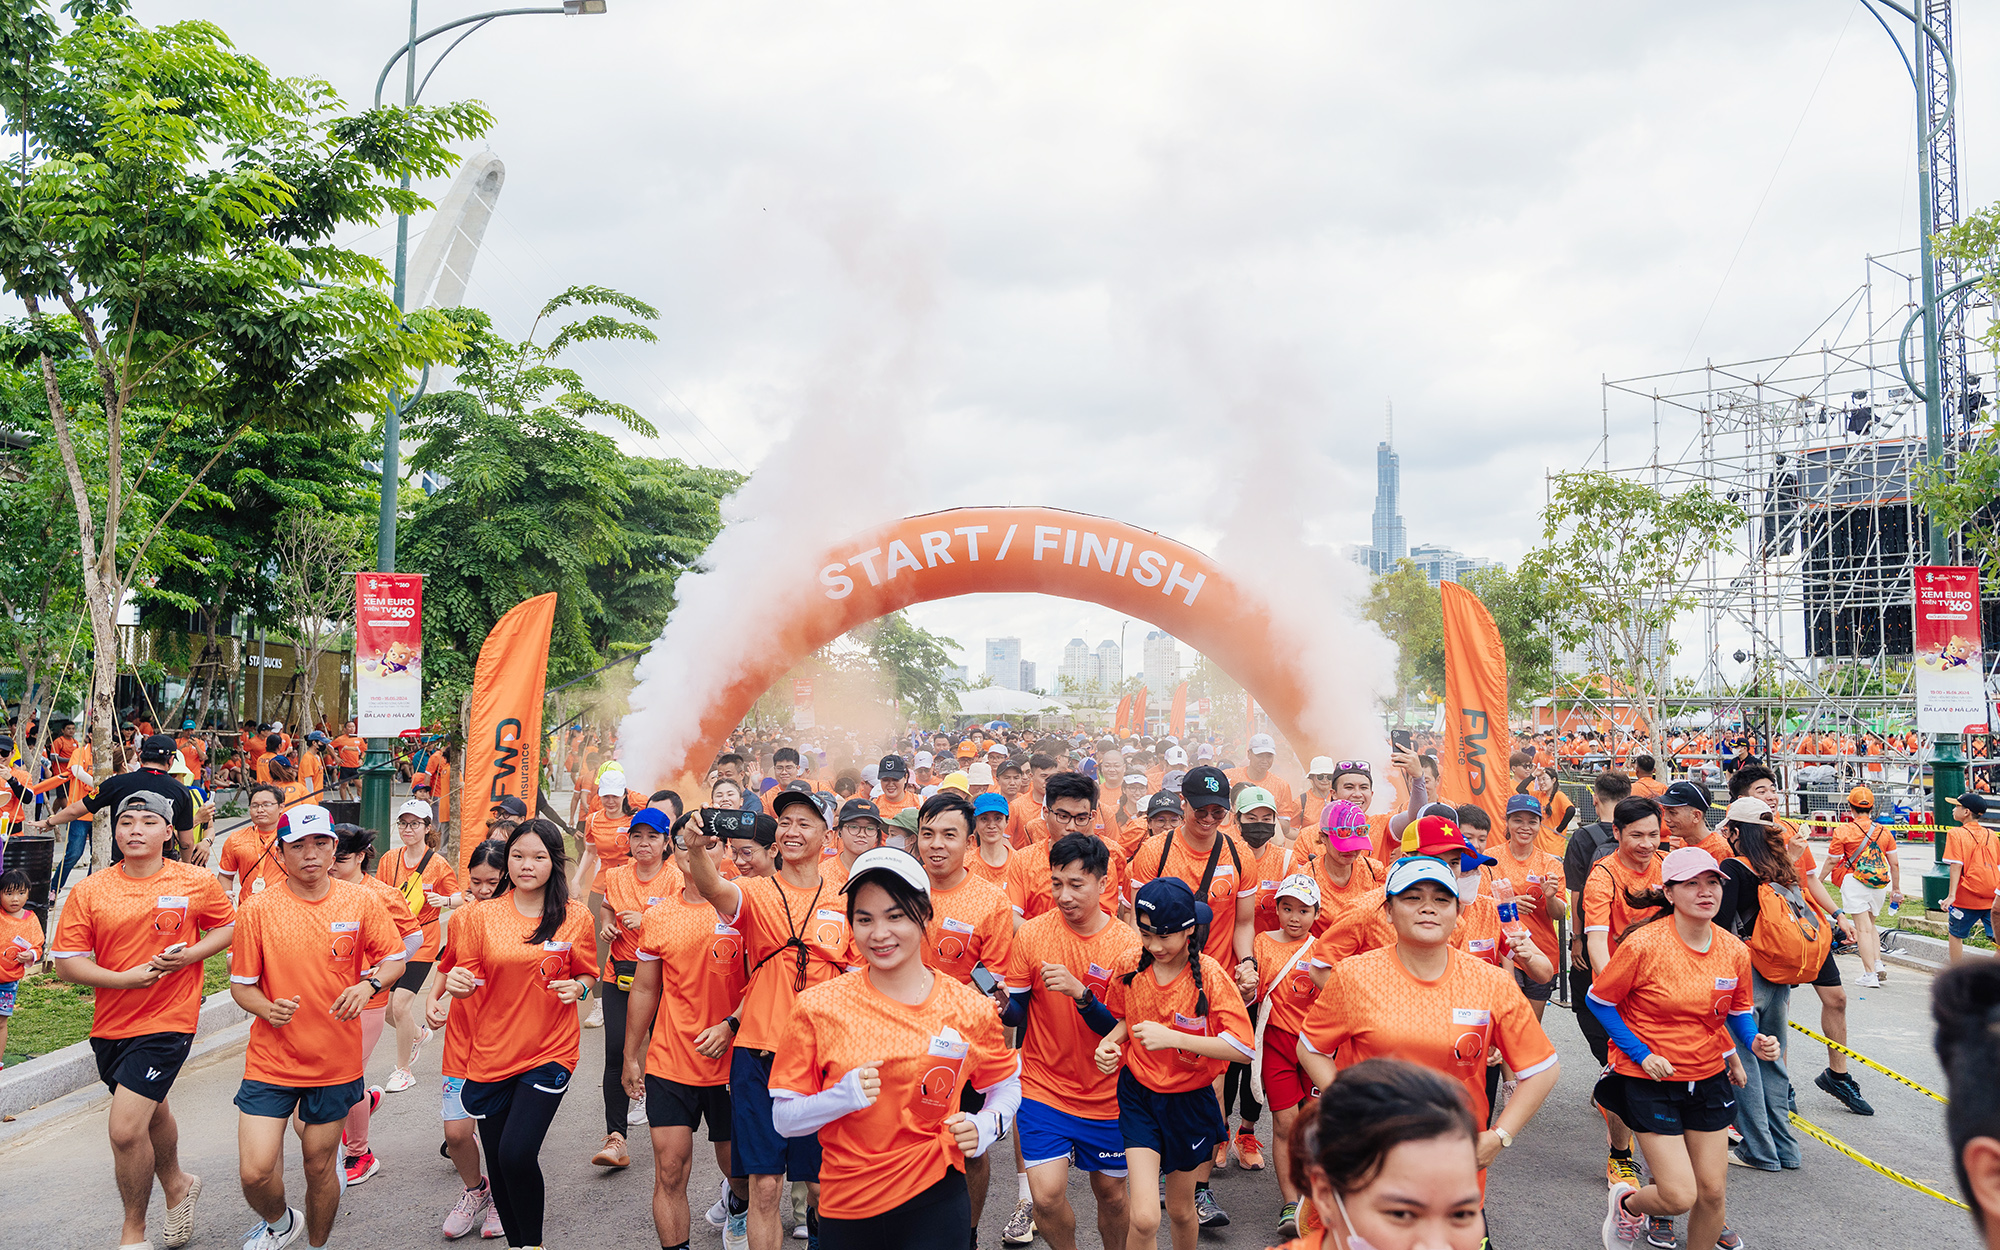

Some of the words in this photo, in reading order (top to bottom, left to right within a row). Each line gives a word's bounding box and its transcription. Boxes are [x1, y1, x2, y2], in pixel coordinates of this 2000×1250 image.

[819, 525, 989, 600] START
[995, 523, 1019, 561] /
[1033, 524, 1207, 607] FINISH
[363, 597, 386, 606] XEM
[387, 598, 415, 606] EURO
[1921, 590, 1943, 599] XEM
[1944, 591, 1972, 599] EURO
[248, 655, 283, 669] STABUCKS
[490, 717, 522, 802] FWD
[1461, 708, 1489, 796] FWD
[520, 742, 530, 800] insurance
[935, 1038, 950, 1048] FWD
